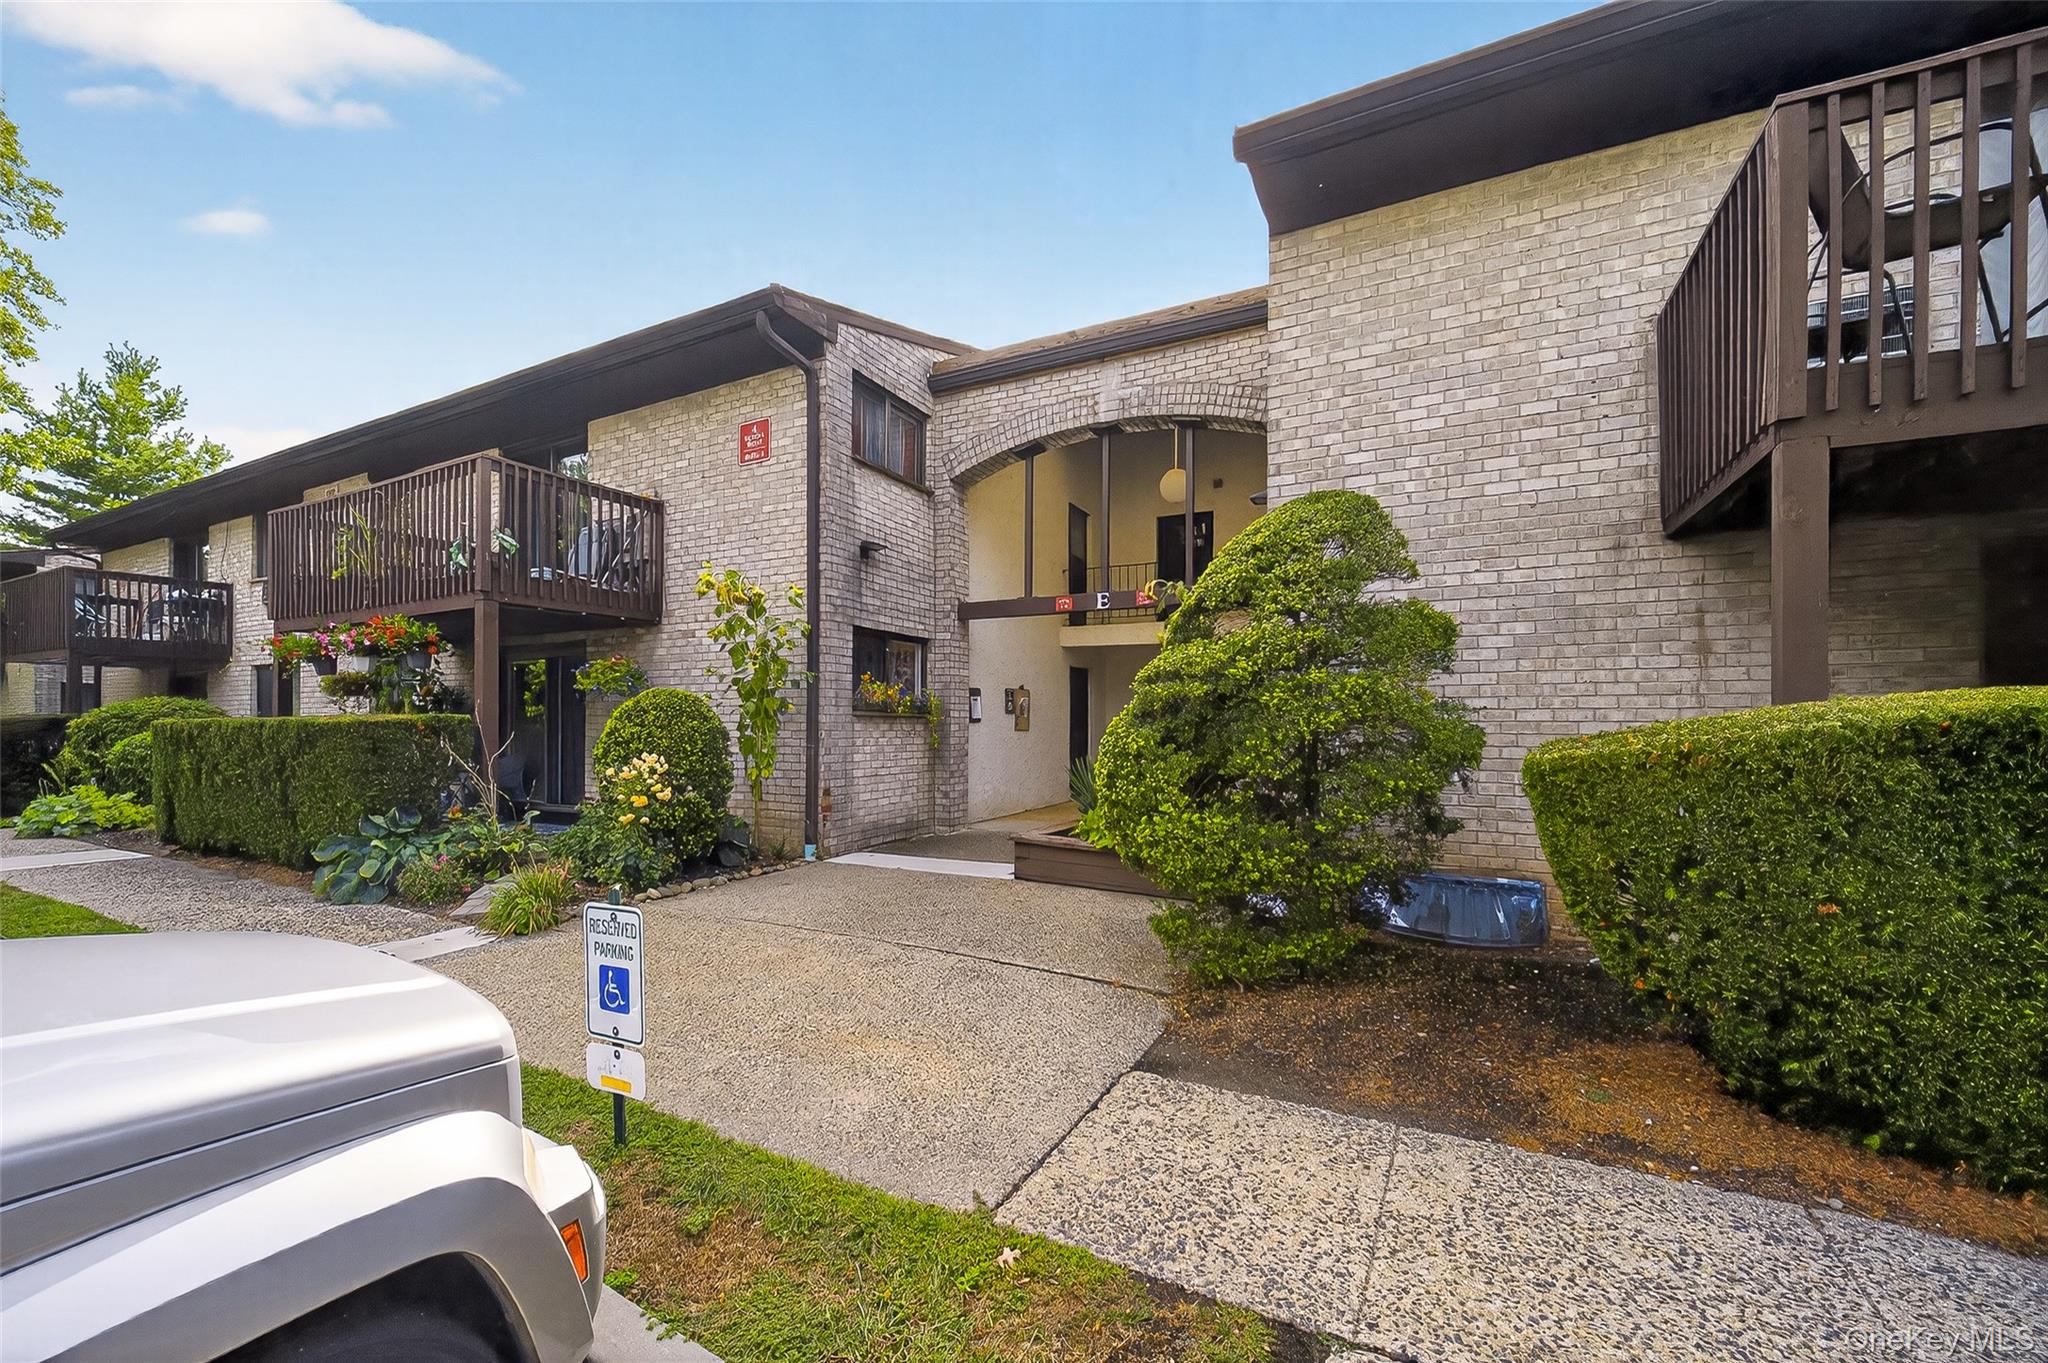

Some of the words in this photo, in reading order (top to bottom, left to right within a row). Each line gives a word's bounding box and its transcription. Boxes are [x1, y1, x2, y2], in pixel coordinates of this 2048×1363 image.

[1096, 592, 1110, 609] E
[589, 917, 637, 939] RESERVED
[594, 941, 634, 961] PARKING
